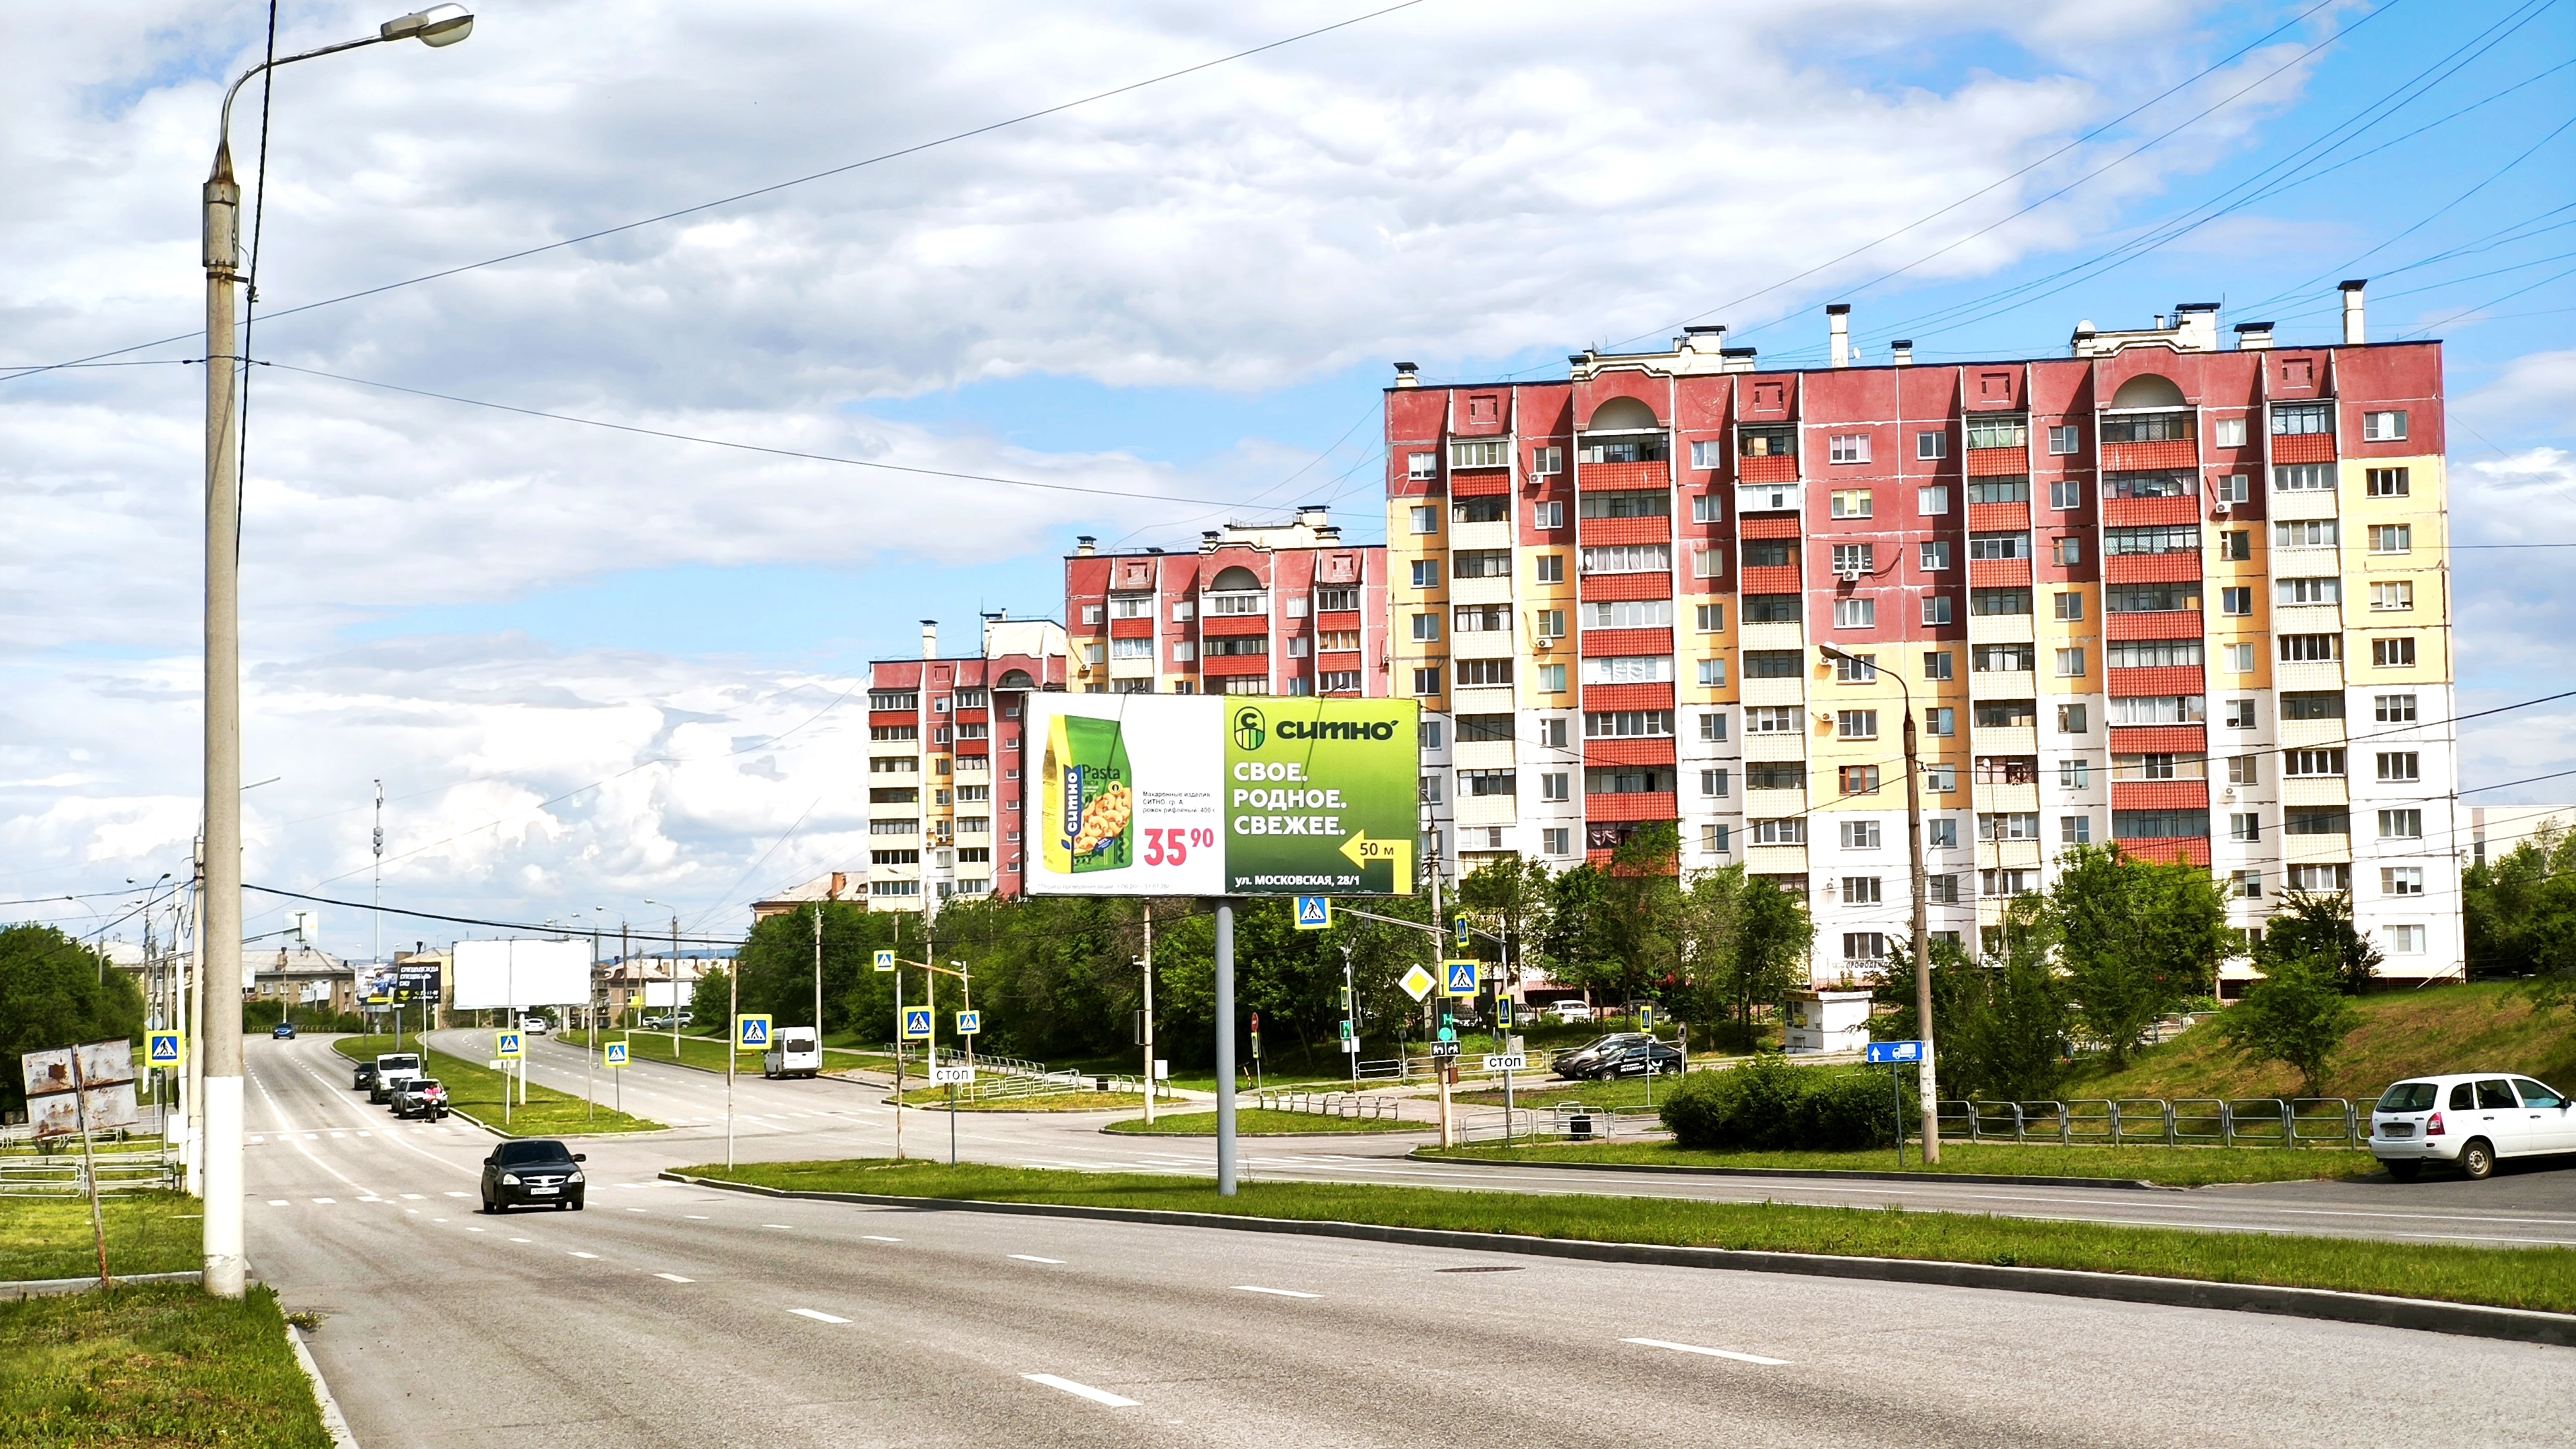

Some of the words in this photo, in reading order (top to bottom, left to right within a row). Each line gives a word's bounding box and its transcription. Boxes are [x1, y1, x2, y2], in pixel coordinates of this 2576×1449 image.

[1082, 765, 1121, 780] Pasta
[1234, 761, 1308, 782] СВОЕ.
[1234, 789, 1347, 811] РОДНОЕ.
[1234, 816, 1346, 835] СВЕЖЕЕ.
[1360, 843, 1378, 856] 50
[1235, 876, 1252, 888] ул.
[1255, 875, 1335, 886] МОСКОВСКАЯ,
[1337, 876, 1359, 886] 28/1
[1489, 1058, 1521, 1067] СТОП
[936, 1070, 969, 1080] СТОП
